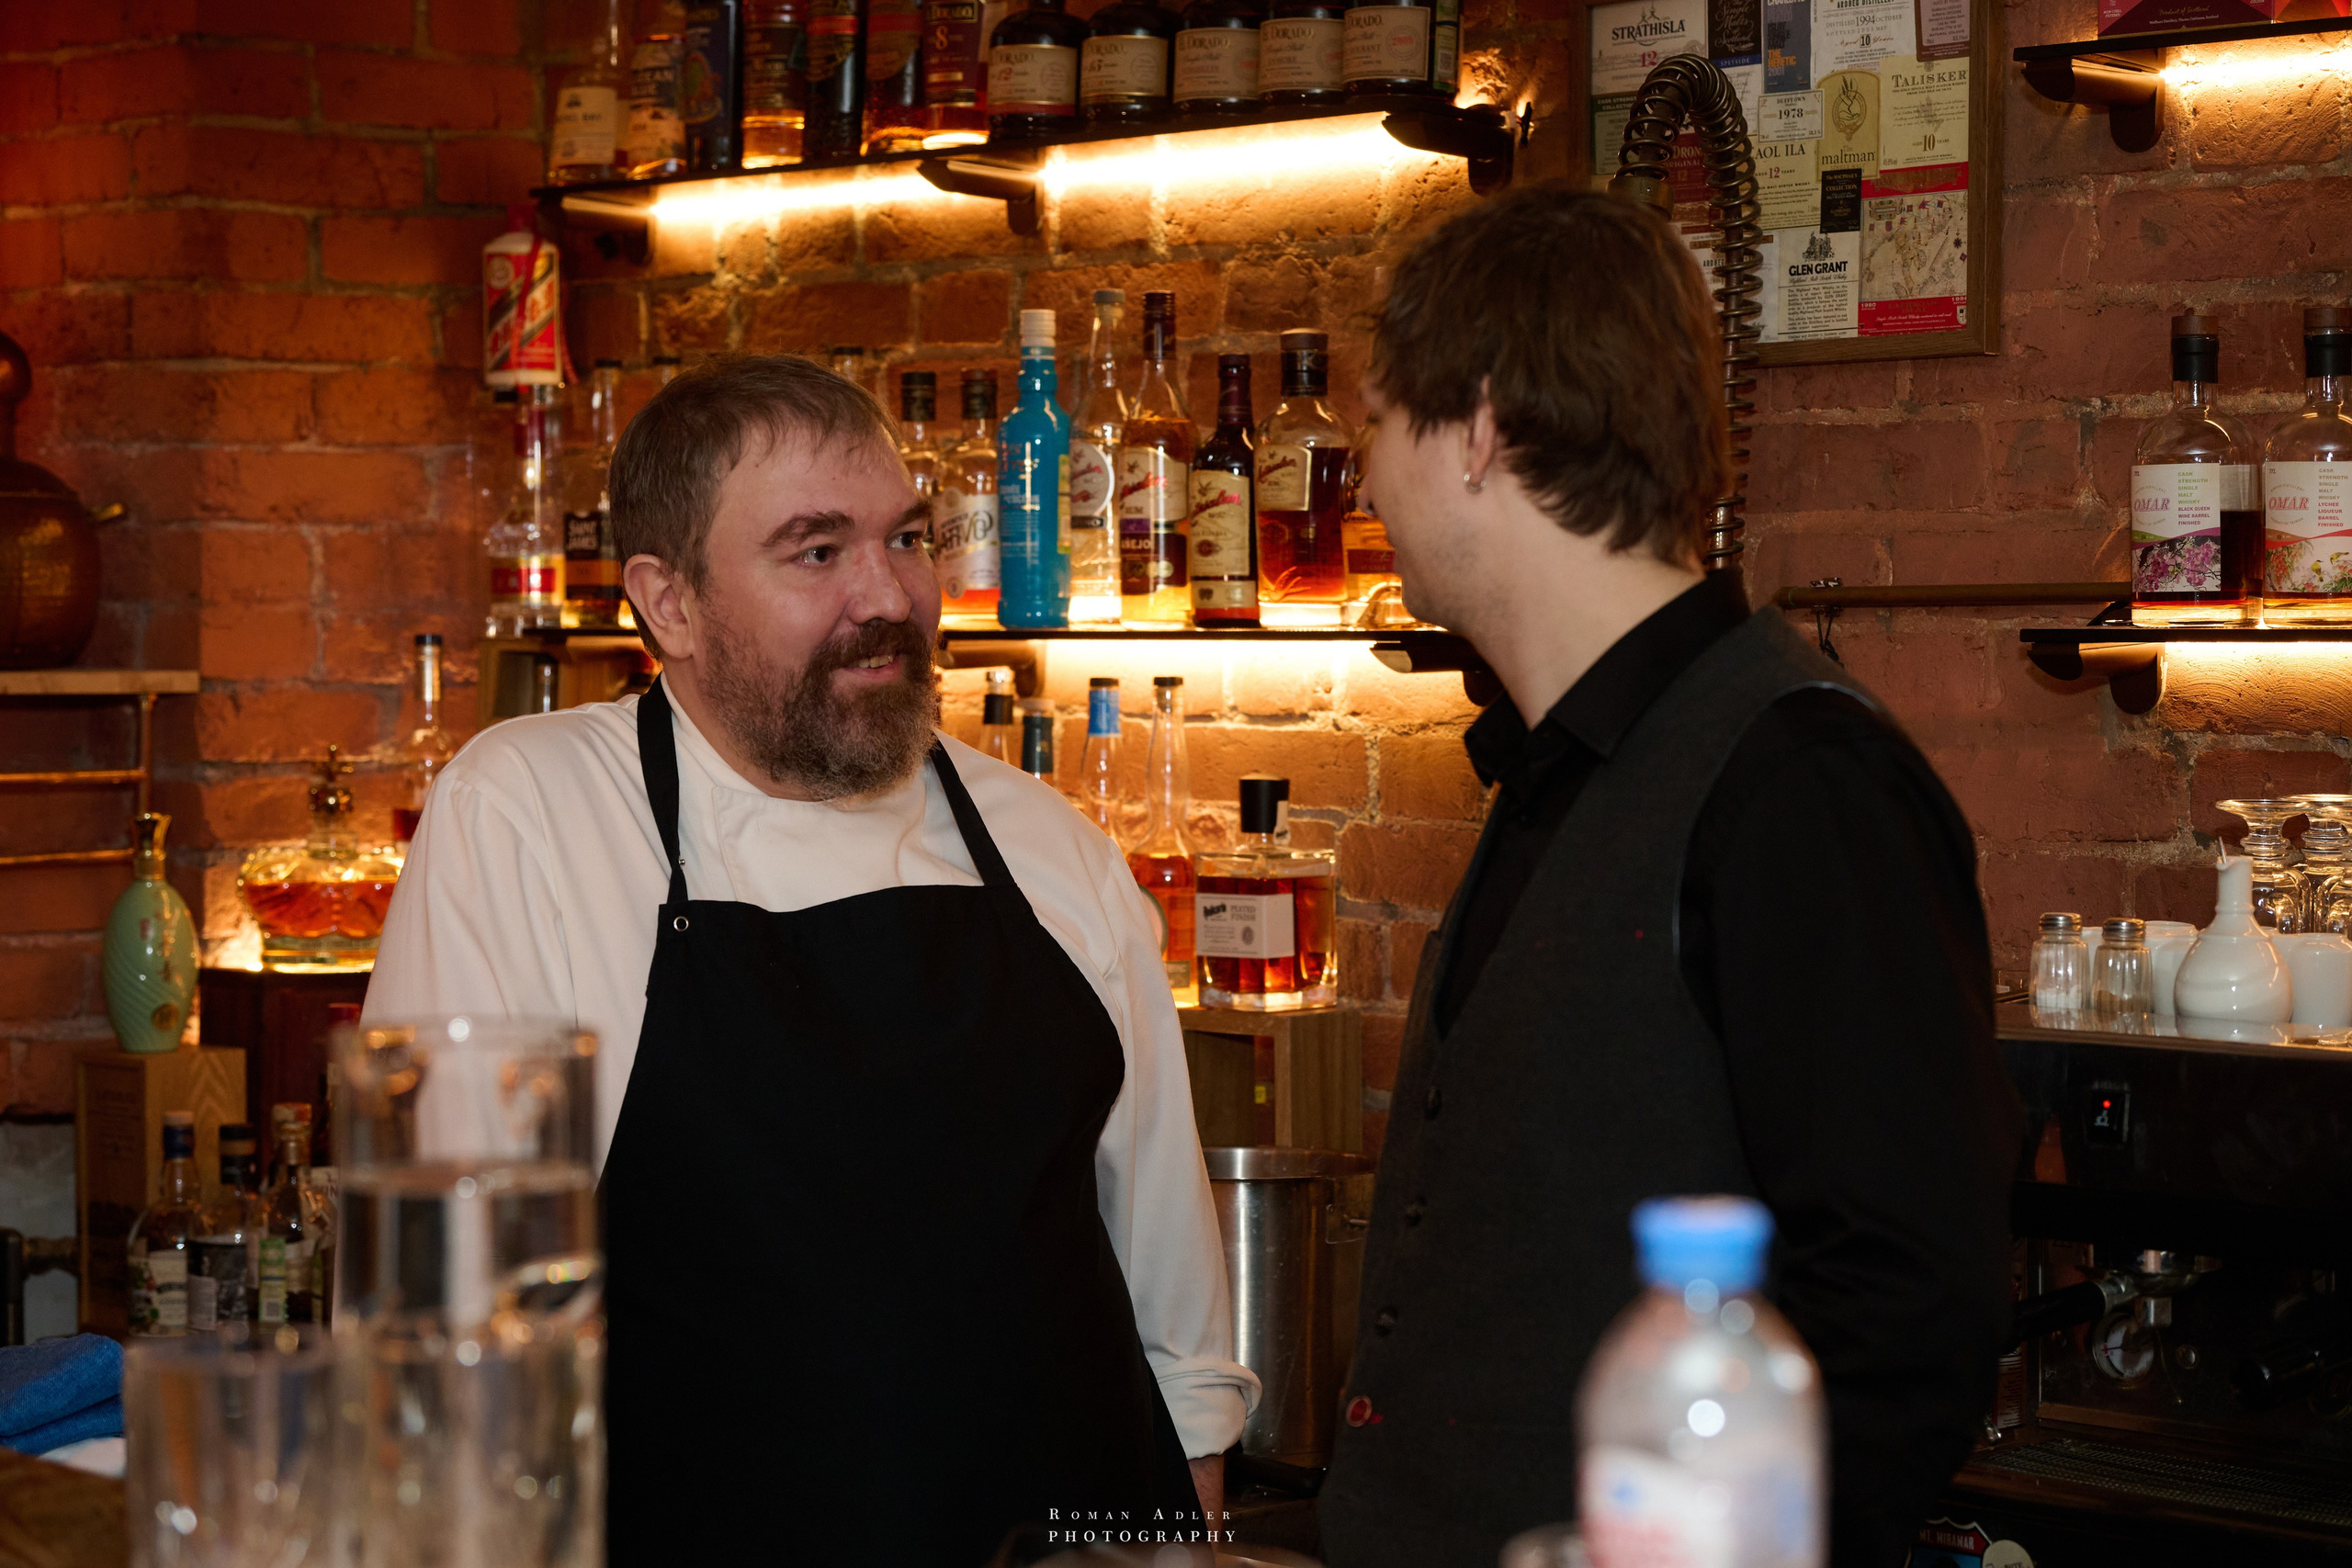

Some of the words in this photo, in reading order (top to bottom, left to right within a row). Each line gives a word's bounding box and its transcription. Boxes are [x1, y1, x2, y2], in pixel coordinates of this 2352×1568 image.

[1826, 19, 1855, 28] DISTILLED
[1856, 15, 1875, 26] 1994
[1876, 14, 1902, 22] OCTOBER
[1611, 19, 1686, 41] STRATHISLA
[935, 25, 948, 51] 8
[1860, 34, 1871, 46] 10
[1641, 51, 1657, 67] 12
[1768, 49, 1781, 59] THE
[1720, 58, 1750, 67] SPEYSIDE
[1892, 70, 1967, 88] TALISKER
[1779, 107, 1804, 119] 1978
[1923, 133, 1935, 152] 10
[1752, 146, 1781, 159] AOL
[1785, 143, 1805, 156] ILA
[1822, 149, 1874, 164] maltman
[1769, 166, 1780, 178] 12
[1789, 264, 1813, 276] GLEN
[1815, 261, 1848, 274] GRANT
[2133, 497, 2170, 512] OMAR
[2268, 495, 2309, 511] OMAR
[1936, 1531, 1974, 1551] MIRAMAR
